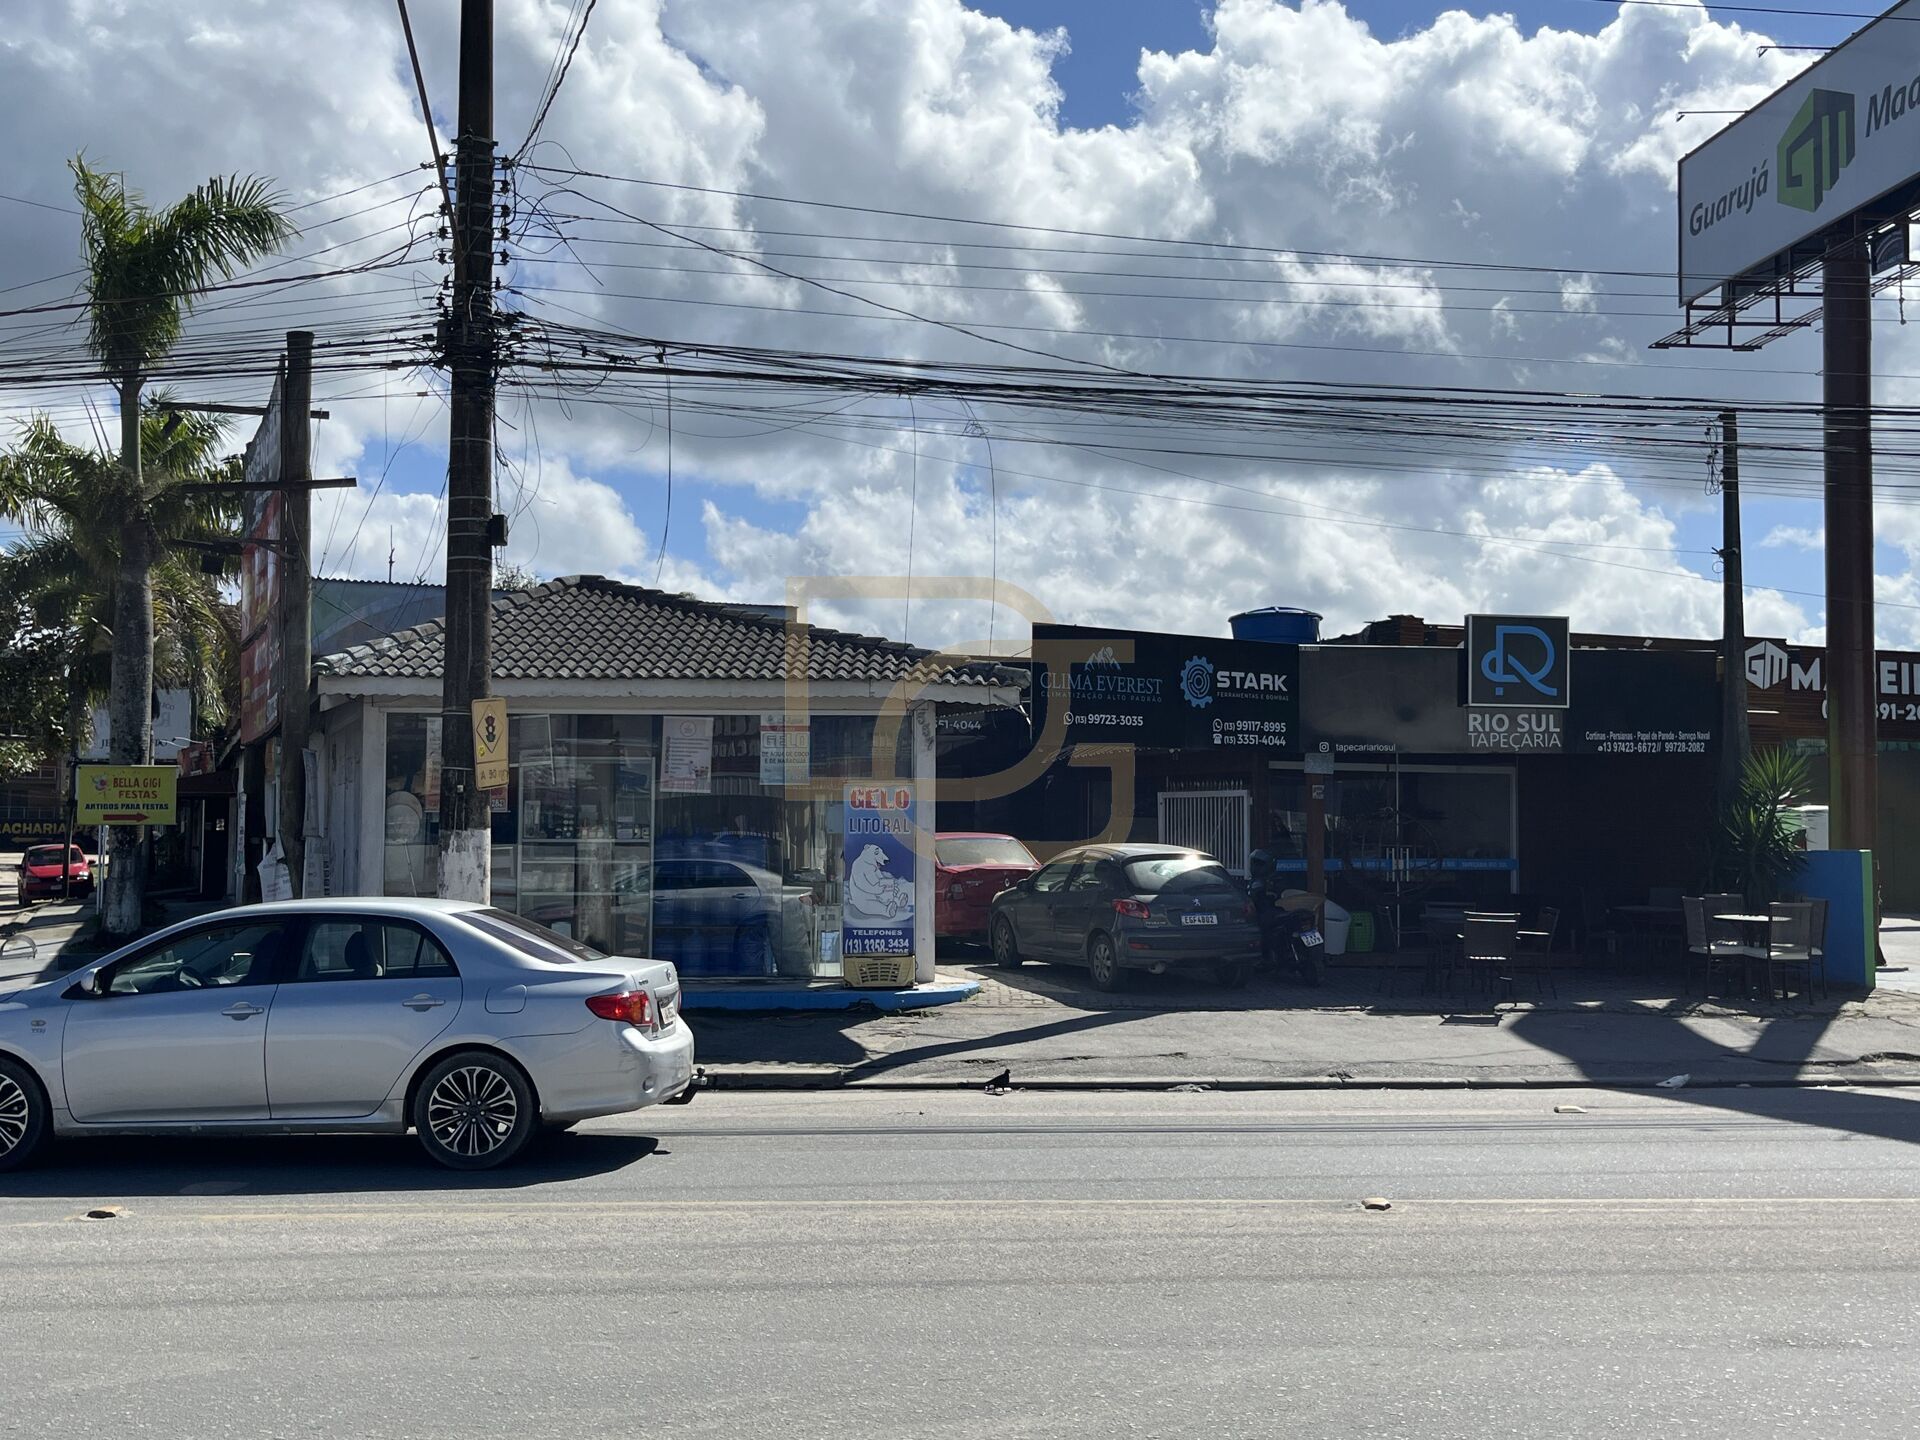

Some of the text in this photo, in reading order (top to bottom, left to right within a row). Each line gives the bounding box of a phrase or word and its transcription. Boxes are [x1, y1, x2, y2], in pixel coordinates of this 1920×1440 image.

[1689, 159, 1769, 237] Guarujá
[1040, 671, 1163, 695] CLIMA EVEREST
[1216, 670, 1288, 692] STARK
[1040, 690, 1103, 701] CLIMATIZAÇÃO
[1131, 694, 1162, 703] PADRÃO
[1216, 691, 1260, 700] FERRAMENTAS
[1075, 713, 1144, 726] (13) 99723-3035
[1468, 713, 1561, 733] RIO SUL
[1224, 720, 1287, 733] (13) 99117-8995
[1224, 734, 1287, 747] (13) 3351-4044
[1468, 733, 1561, 750] TAPEÇARIA
[1335, 743, 1396, 753] tapecariariosul
[1665, 742, 1705, 753] 99728-2082
[113, 777, 161, 788] BELLA GIGI
[118, 790, 158, 799] FESTAS
[850, 786, 910, 810] GELO
[85, 803, 169, 811] ARTIGOS PARA FESTAS
[0, 822, 66, 835] ACHARIA
[849, 817, 911, 834] LITORAL
[888, 938, 910, 948] 3434
